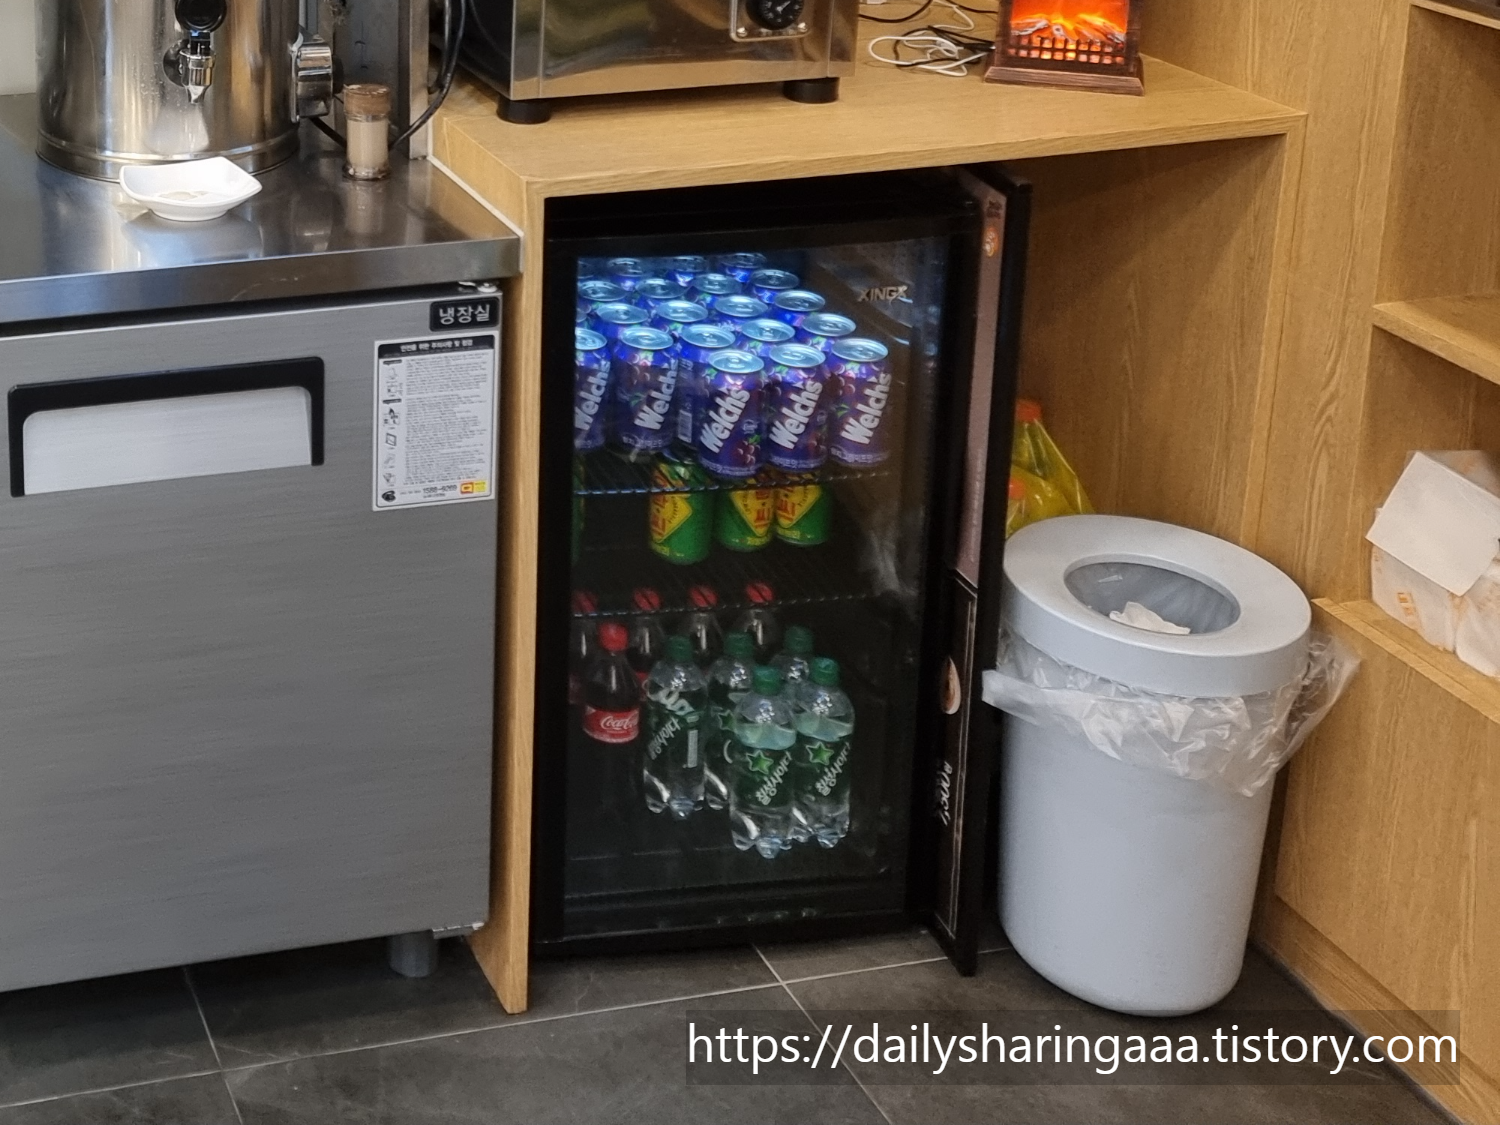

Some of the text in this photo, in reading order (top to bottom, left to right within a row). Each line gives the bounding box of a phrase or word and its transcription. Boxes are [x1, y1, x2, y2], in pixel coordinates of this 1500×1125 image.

[438, 303, 491, 325] 냉장실
[756, 751, 792, 806] 칠성사이다
[815, 741, 851, 797] 칠성사이다
